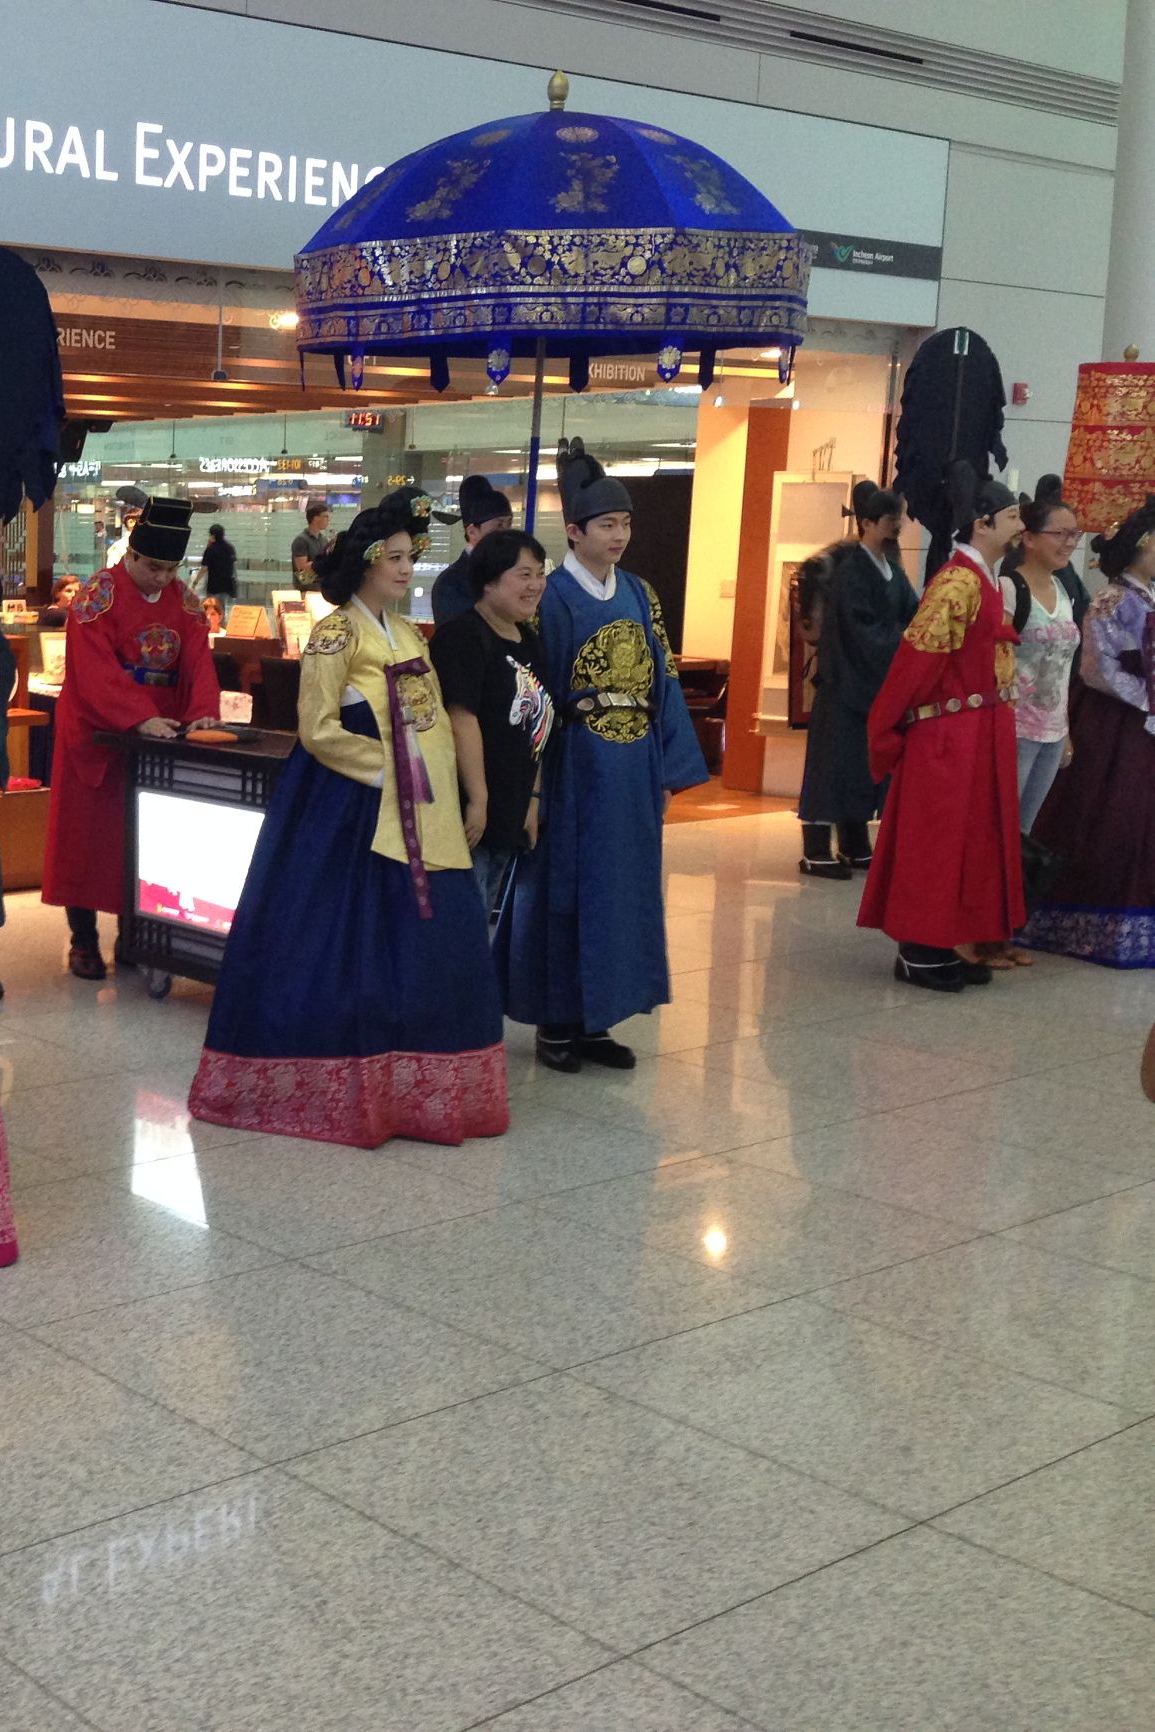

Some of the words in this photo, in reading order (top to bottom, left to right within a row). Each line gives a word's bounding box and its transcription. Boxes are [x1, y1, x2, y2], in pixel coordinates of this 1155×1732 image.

[135, 121, 386, 208] EXPERIEN
[56, 327, 116, 350] RIENCE
[589, 362, 646, 382] XHIBITION
